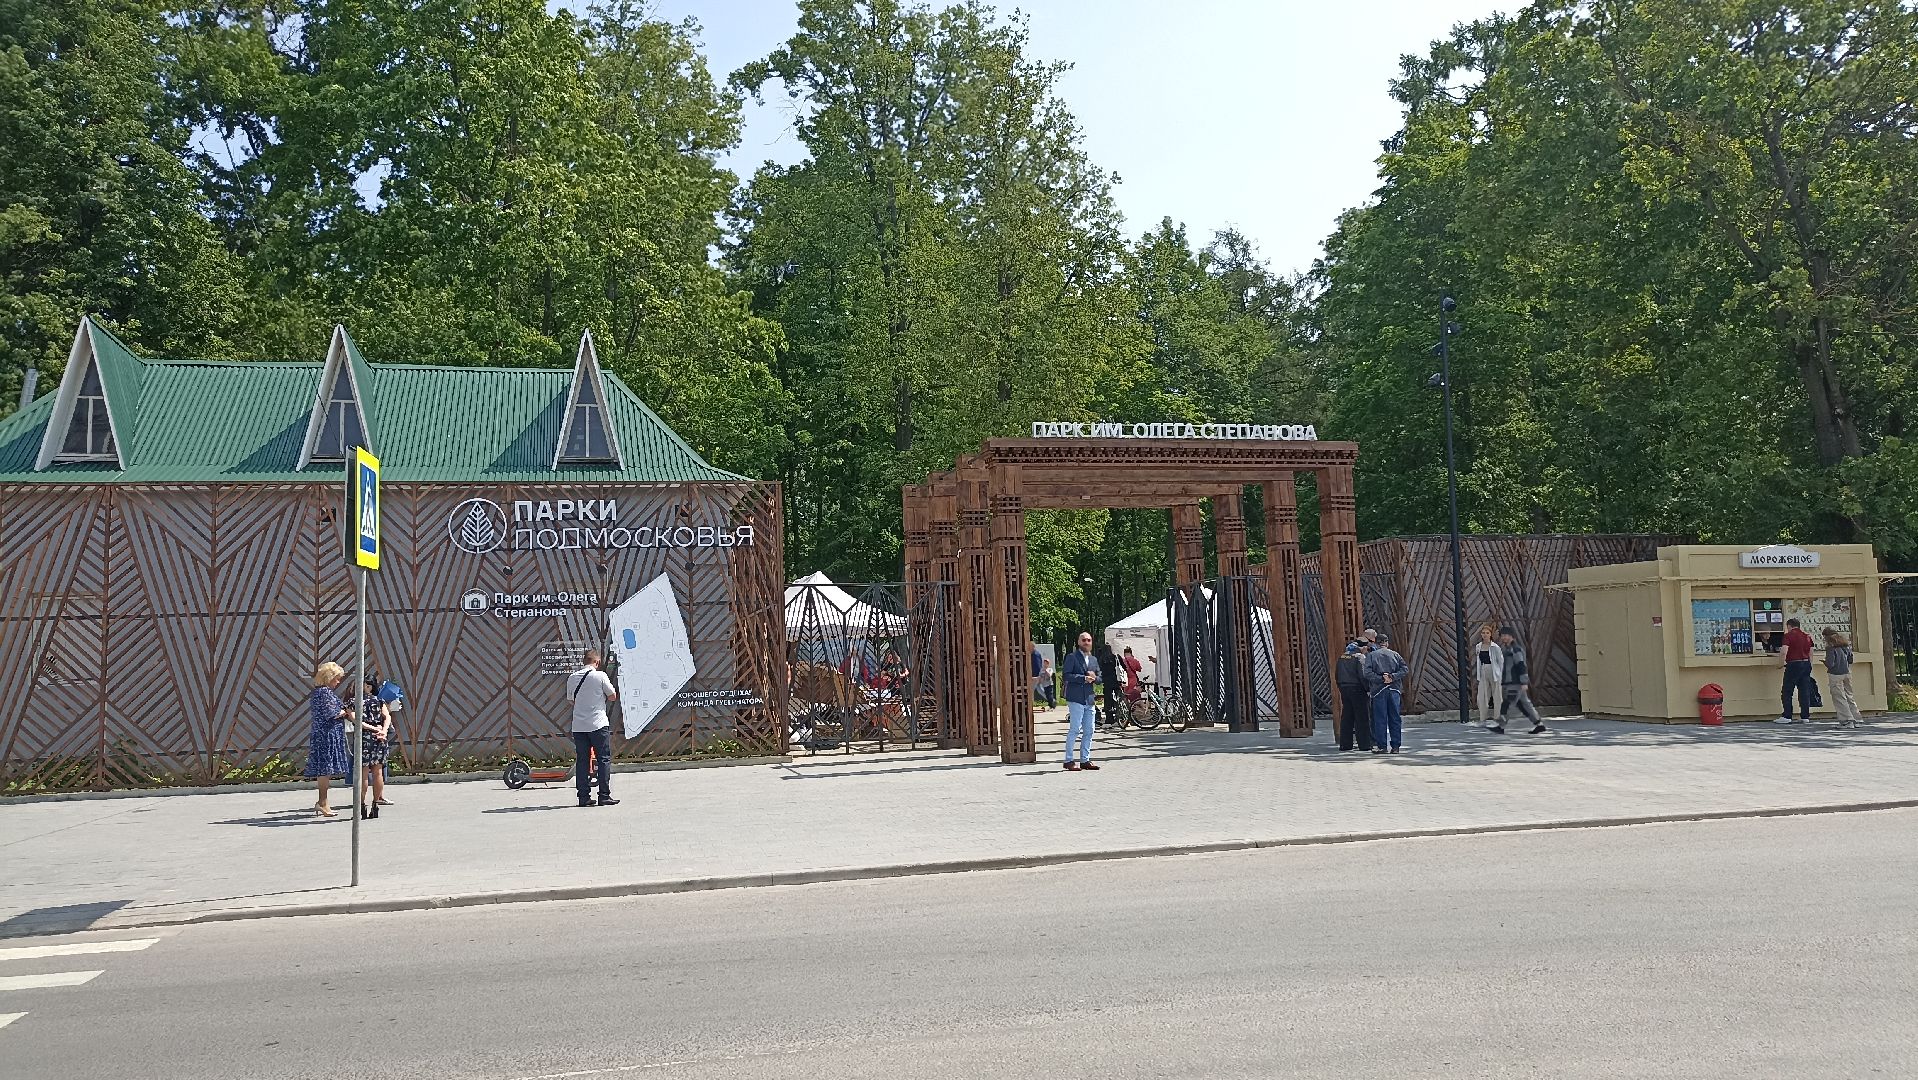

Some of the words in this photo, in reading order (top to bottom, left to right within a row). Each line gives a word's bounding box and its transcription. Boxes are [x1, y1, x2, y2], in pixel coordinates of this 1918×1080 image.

[1032, 421, 1084, 438] ПАРК
[1133, 422, 1196, 439] ОЛЕГА
[1200, 423, 1318, 441] СТЕПАНОВА
[514, 499, 618, 522] ПАРКИ
[515, 525, 754, 550] ПОДМОСКОВЬЯ
[1750, 554, 1813, 565] МОРОЖЕНОЕ
[494, 592, 529, 606] Парк
[532, 593, 555, 604] им.
[557, 591, 597, 603] Олега
[494, 606, 567, 618] Степанова
[677, 690, 719, 699] ХОРОШЕГО
[677, 699, 714, 708] КОМАНДА
